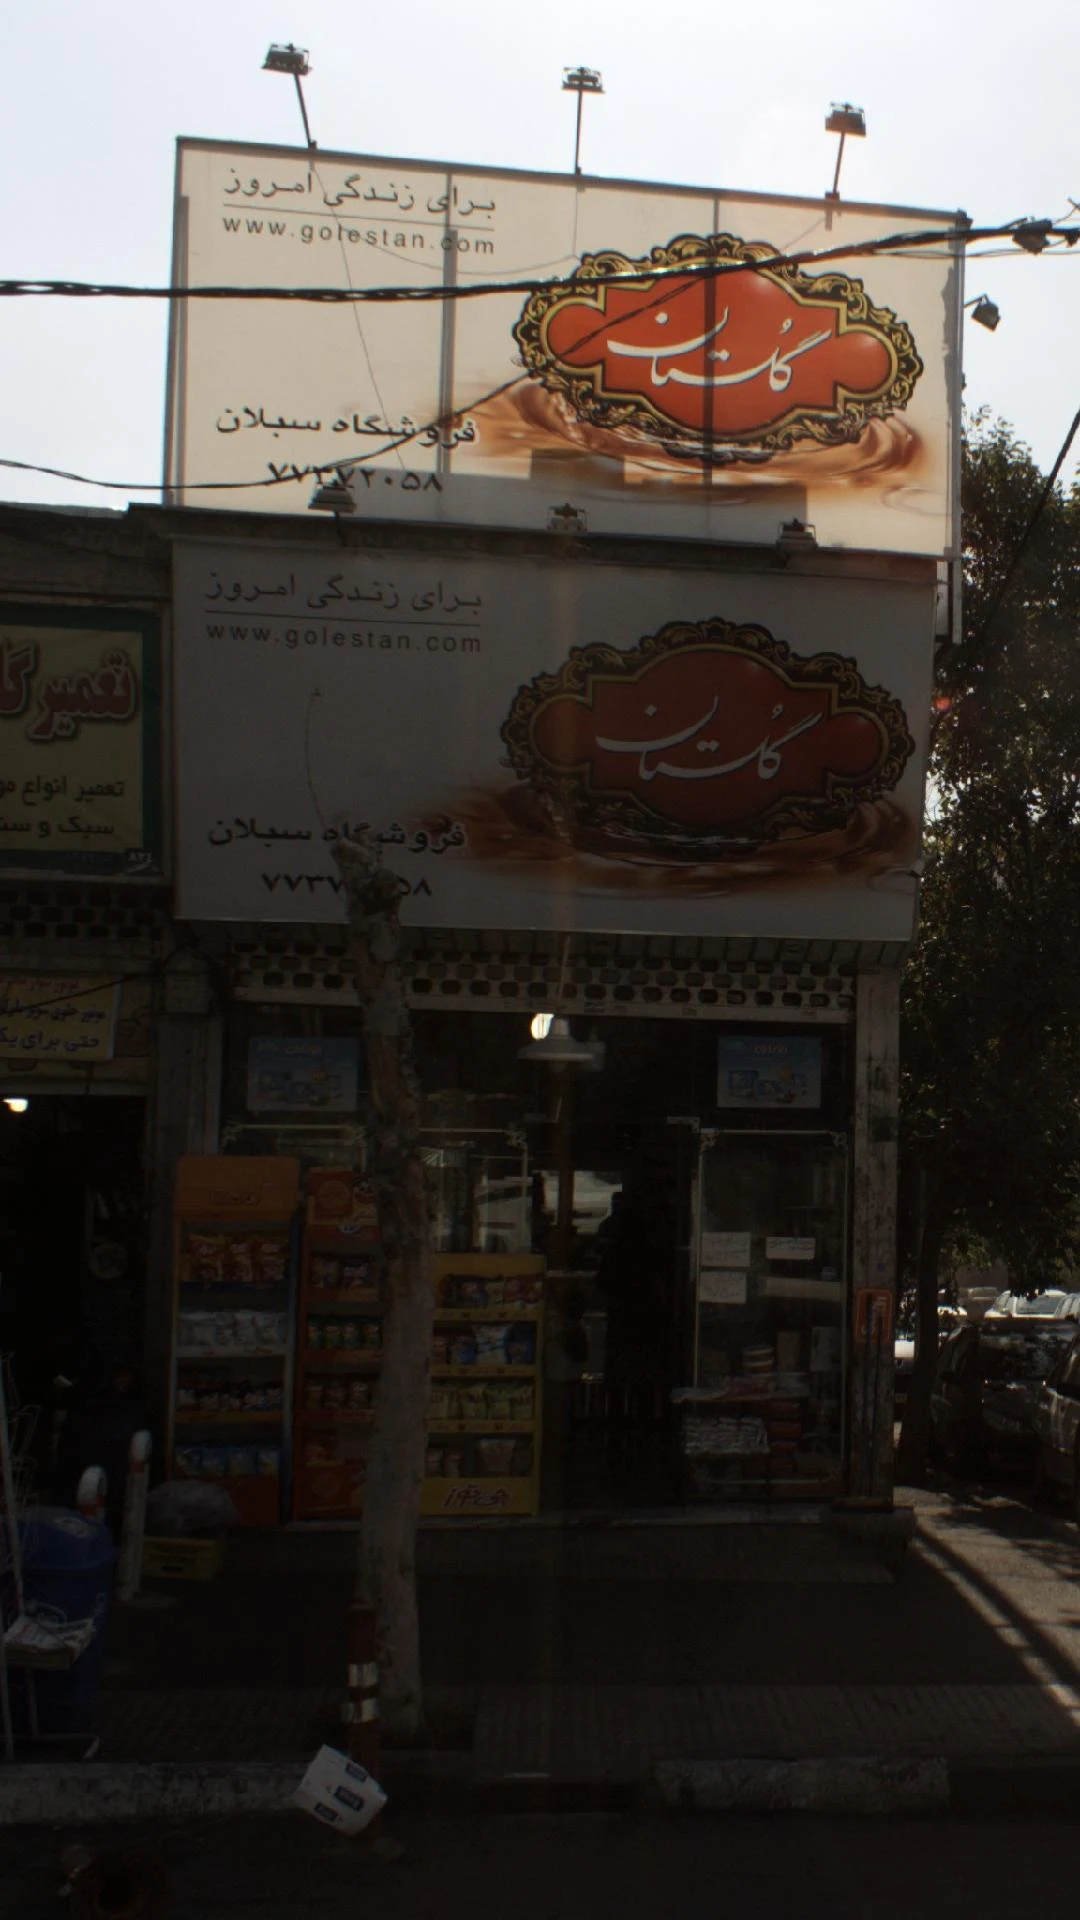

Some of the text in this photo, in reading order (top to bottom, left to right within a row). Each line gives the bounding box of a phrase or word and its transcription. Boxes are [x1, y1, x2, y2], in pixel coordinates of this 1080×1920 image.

[223, 167, 496, 219] برای زندگی امروز
[222, 215, 495, 255] www.golestan.com
[215, 406, 477, 450] فروشگاه سبلان
[205, 571, 483, 615] برای زندگی امروز
[205, 622, 482, 654] www.golestan.com
[22, 774, 68, 807] انواع
[208, 815, 313, 848] سبلان
[261, 872, 433, 897] ۷۷۳۷۵۸
